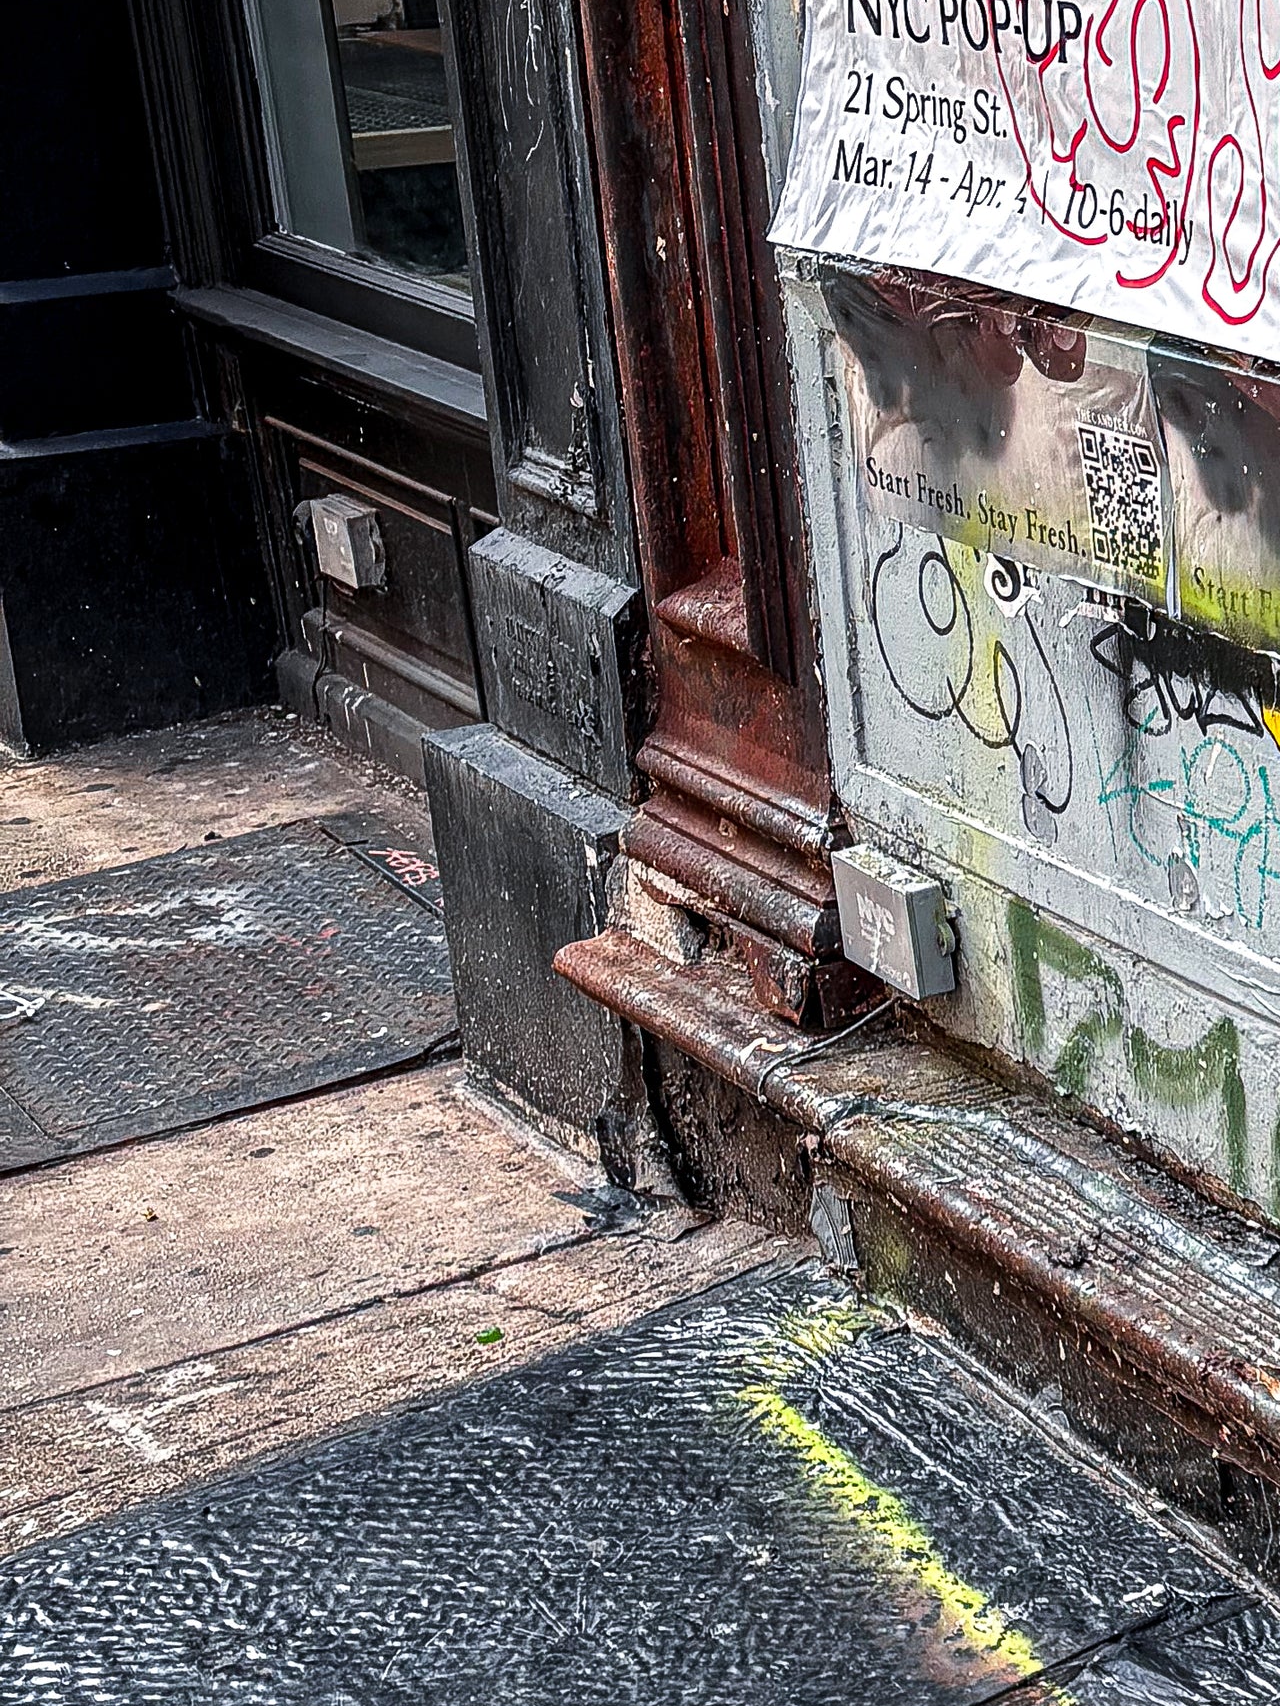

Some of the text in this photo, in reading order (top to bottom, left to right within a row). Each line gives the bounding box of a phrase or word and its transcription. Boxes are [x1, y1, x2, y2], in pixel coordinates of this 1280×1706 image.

[844, 71, 1008, 144] 21 Spring St.
[833, 140, 894, 190] Mar.
[904, 151, 933, 195] 14
[950, 161, 1002, 218] Apr.
[1132, 193, 1194, 265] daily
[866, 456, 1087, 558] Start Fresh. Stay Fresh.
[1194, 565, 1250, 618] Start
